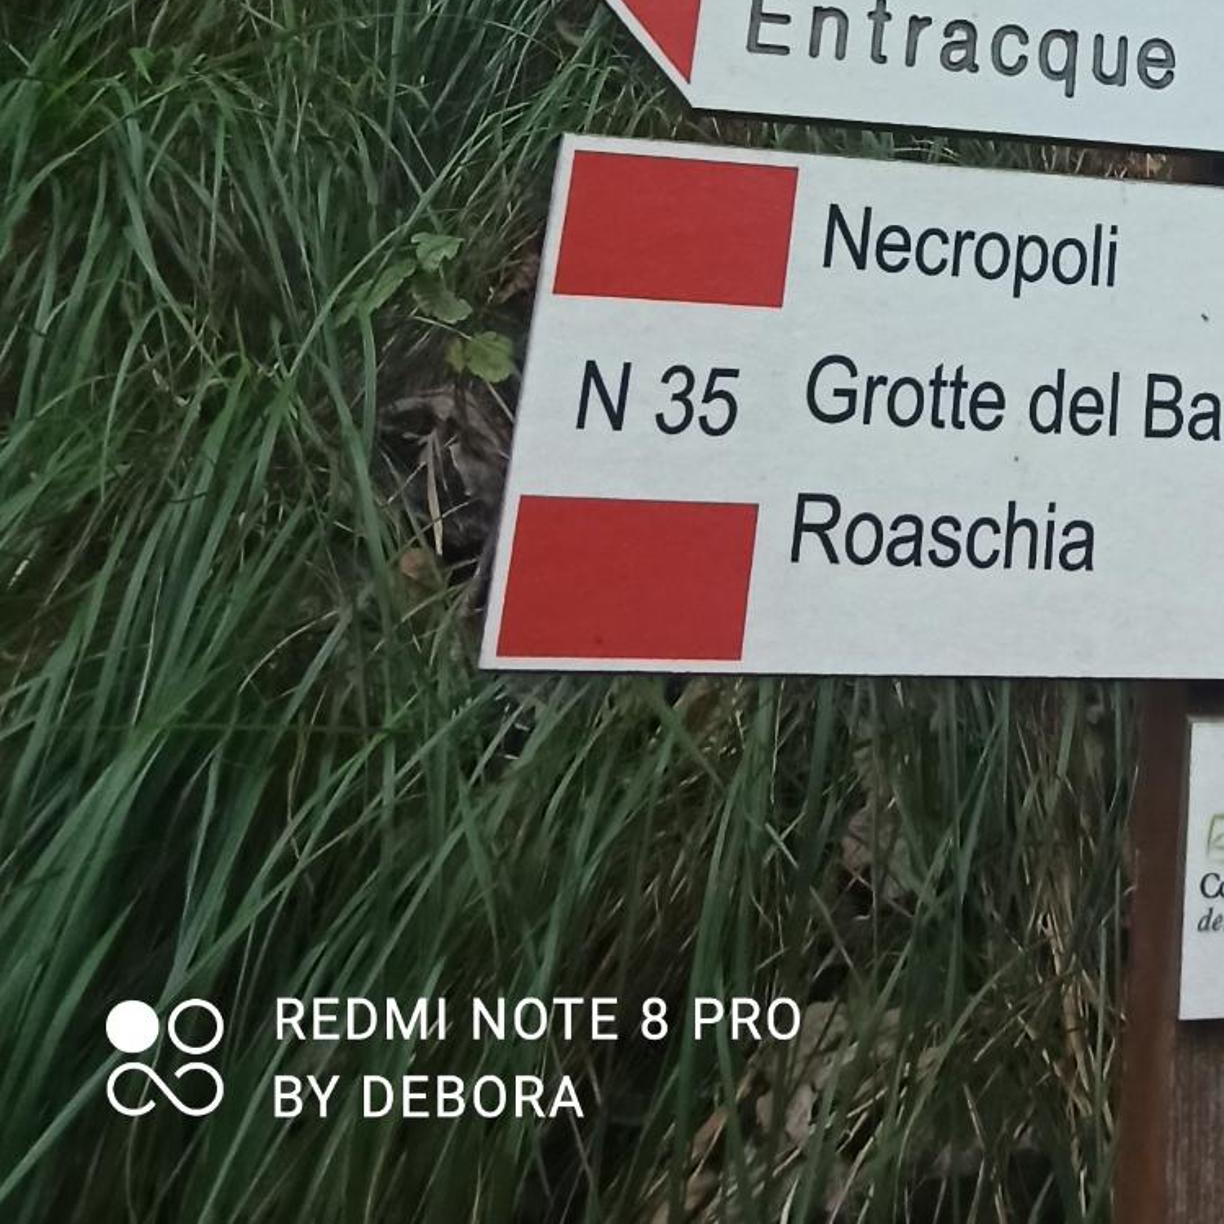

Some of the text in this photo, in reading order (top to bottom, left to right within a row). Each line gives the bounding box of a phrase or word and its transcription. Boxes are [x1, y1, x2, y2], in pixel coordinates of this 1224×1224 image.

[823, 204, 1117, 298] Necropoli
[576, 360, 739, 436] N 35
[807, 355, 1005, 431] Grotte
[1030, 369, 1119, 436] del
[791, 493, 1094, 571] Roaschia
